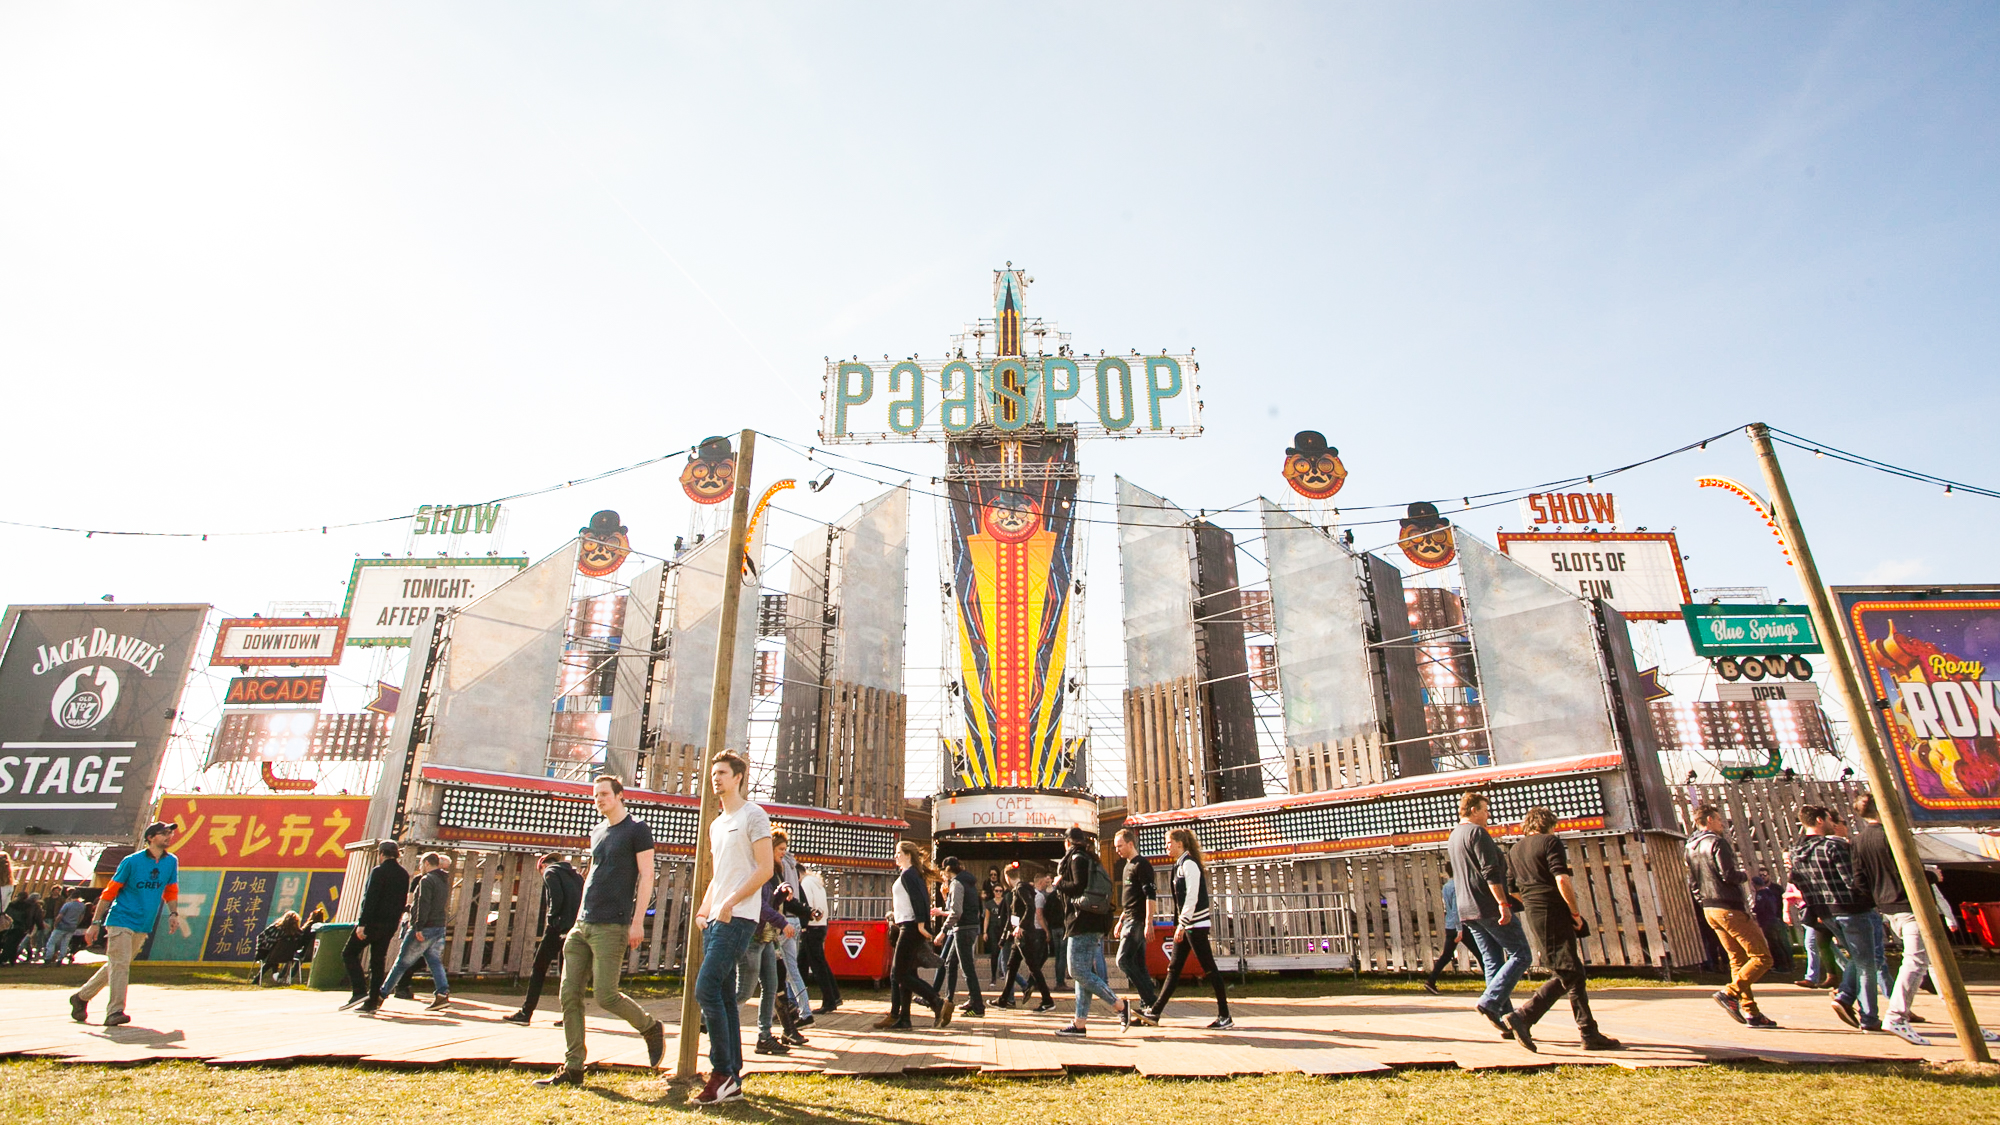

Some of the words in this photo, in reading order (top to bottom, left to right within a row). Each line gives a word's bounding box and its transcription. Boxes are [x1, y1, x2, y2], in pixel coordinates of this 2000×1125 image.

[1528, 493, 1615, 523] SHOW
[414, 504, 502, 534] SHOW
[1551, 552, 1604, 572] SLOTS
[1605, 552, 1626, 572] OF
[402, 578, 475, 599] TONIGHT:
[1579, 579, 1614, 599] FUN
[376, 606, 431, 626] AFTER
[1710, 618, 1745, 641] Blue
[1748, 618, 1799, 643] Springs
[242, 633, 321, 650] DOWNTOWN
[32, 635, 88, 676] JACK
[87, 627, 165, 678] DANIEL'S
[1721, 658, 1809, 678] BOWL
[1928, 654, 1985, 680] Roxy
[230, 679, 323, 701] ARCADE
[1751, 686, 1787, 700] OPEN
[1899, 681, 2000, 738] ROX
[0, 755, 132, 795] STAGE
[996, 797, 1034, 810] CAFE
[973, 811, 1017, 825] DOLLE
[1026, 811, 1057, 825] MINA
